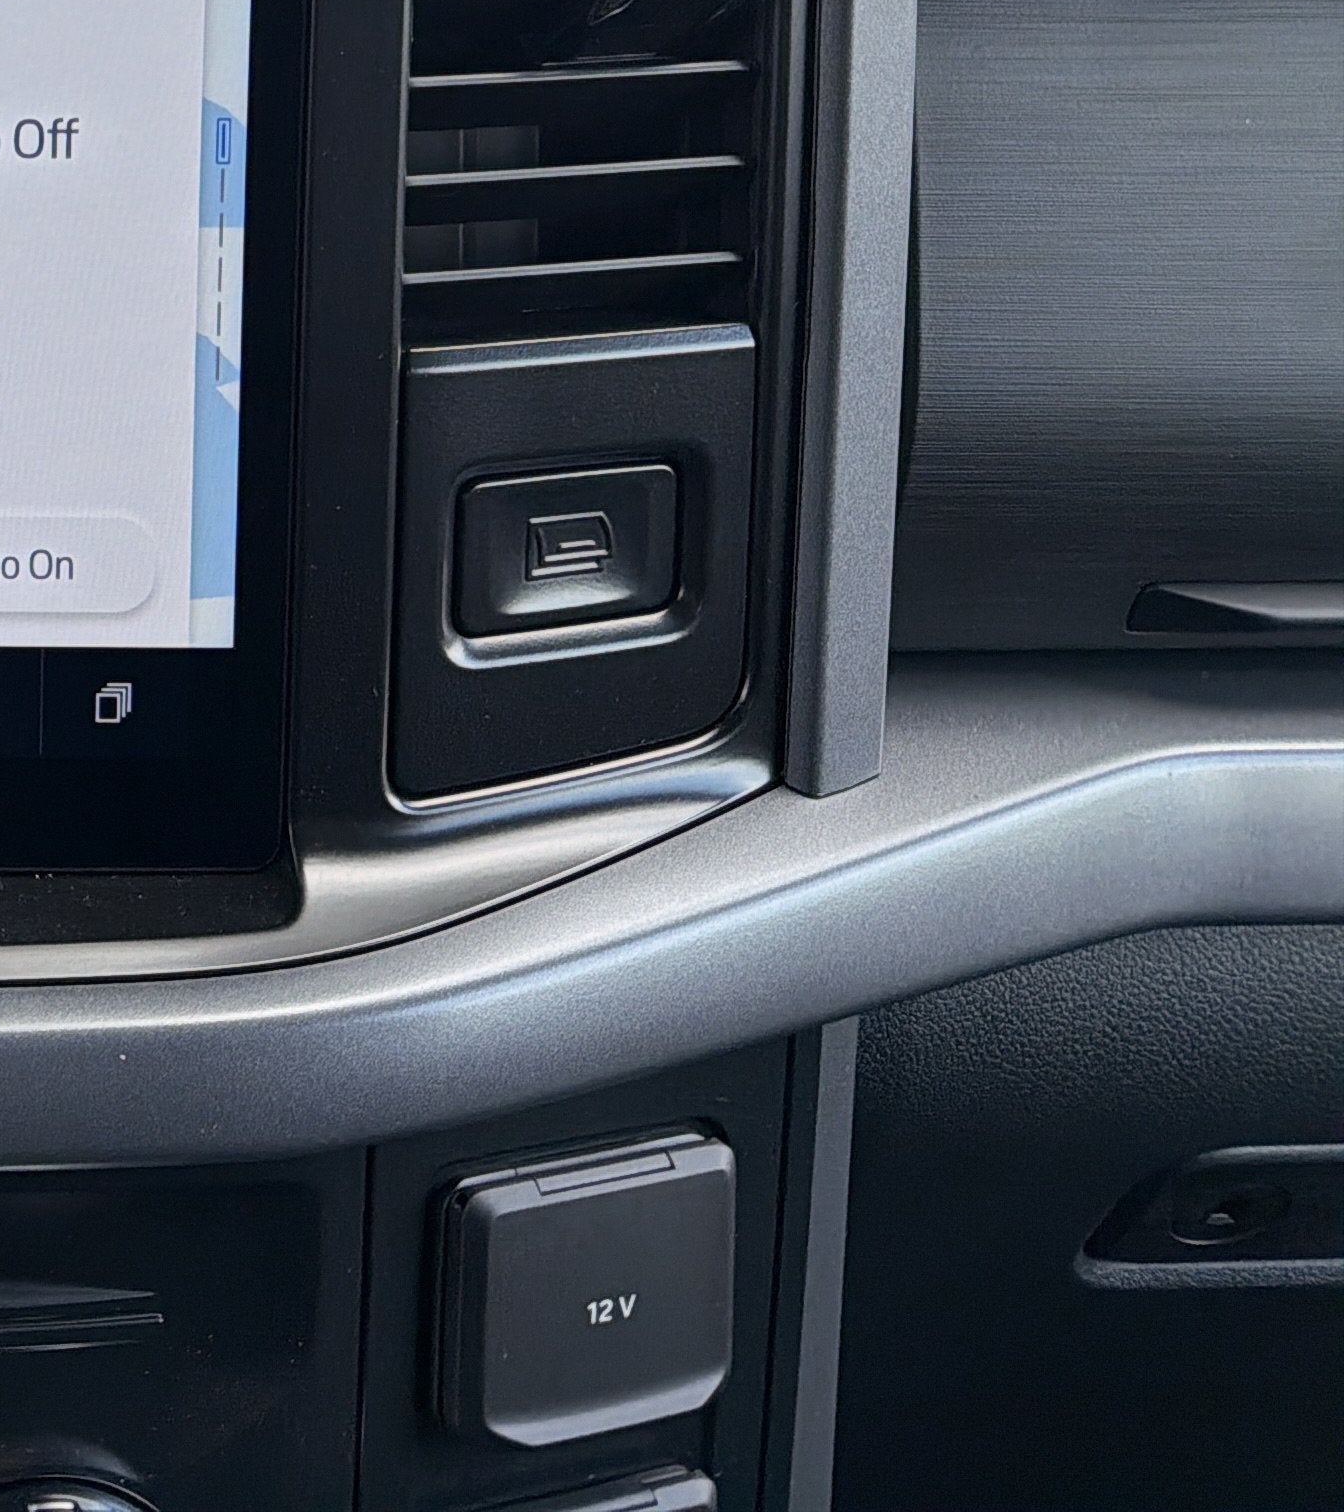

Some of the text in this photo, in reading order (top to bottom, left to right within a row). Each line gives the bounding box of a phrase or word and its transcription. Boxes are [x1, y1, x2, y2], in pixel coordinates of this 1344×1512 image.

[13, 117, 80, 160] Off
[28, 549, 75, 581] On
[586, 1293, 638, 1325] 12 V
